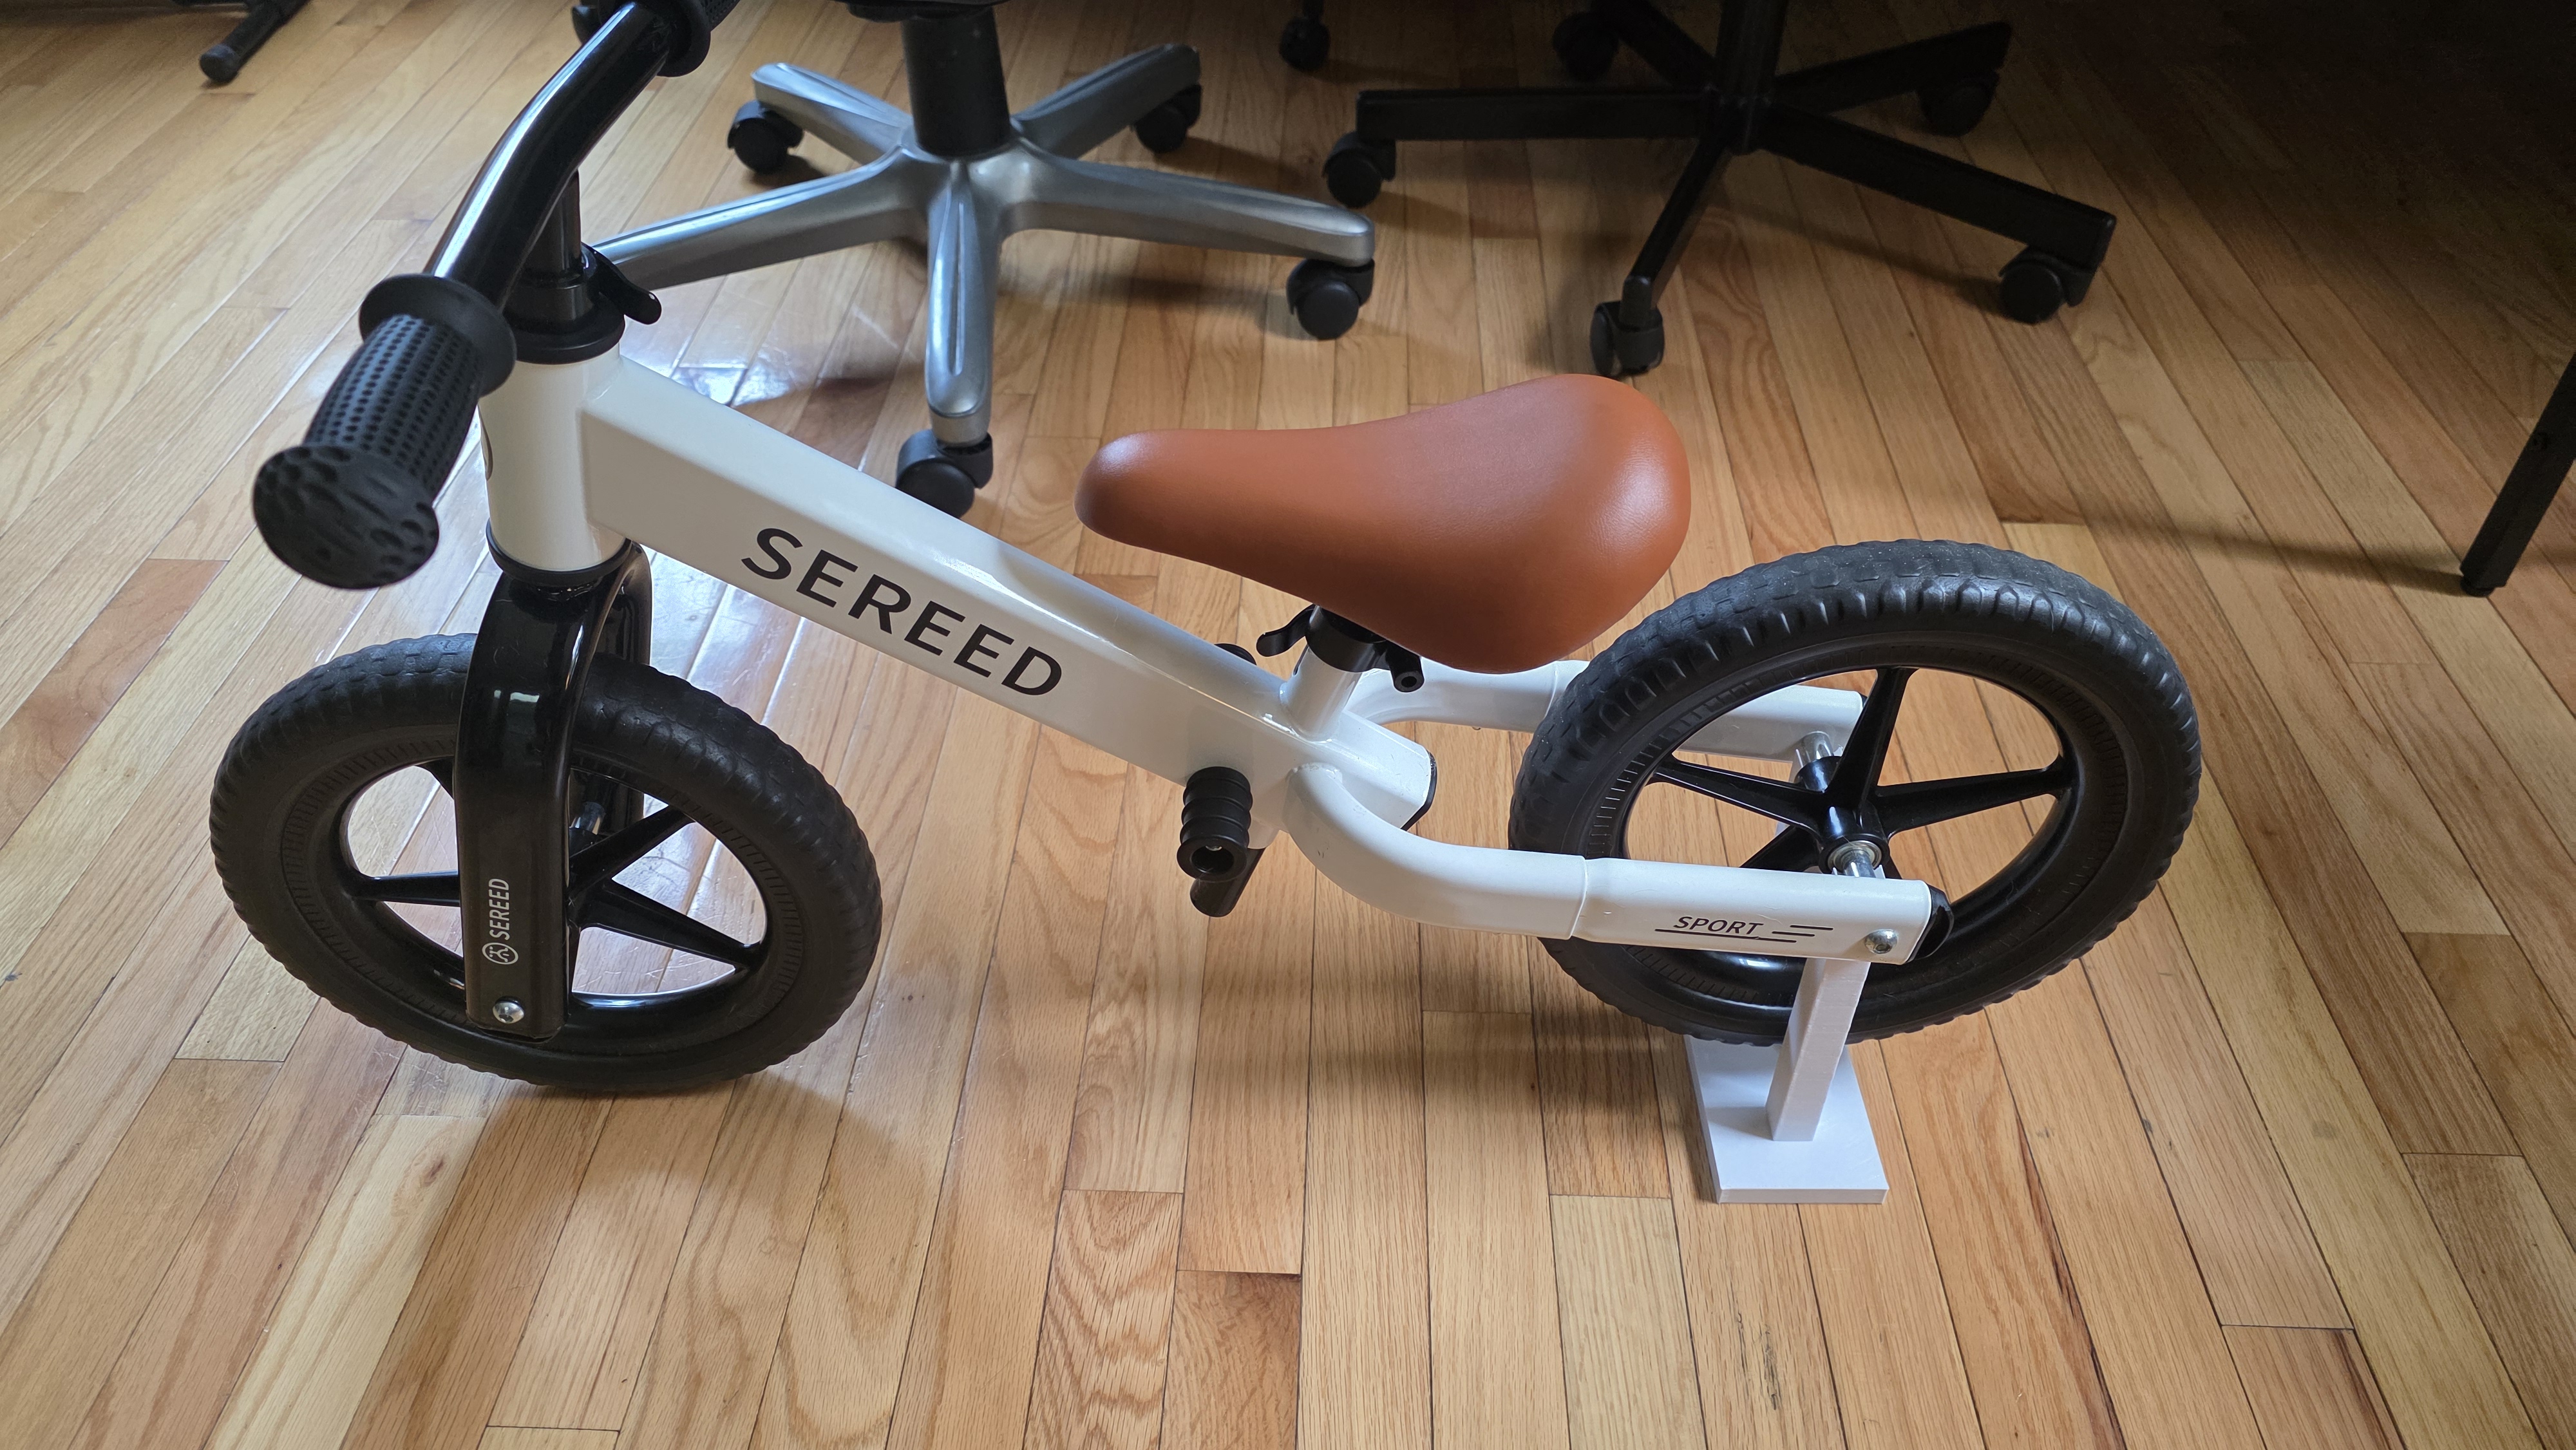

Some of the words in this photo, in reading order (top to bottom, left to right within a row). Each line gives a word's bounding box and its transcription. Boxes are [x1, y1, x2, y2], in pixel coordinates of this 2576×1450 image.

[741, 528, 1063, 695] SEREED
[489, 878, 509, 941] SEREED
[1673, 916, 1764, 935] SPORT
